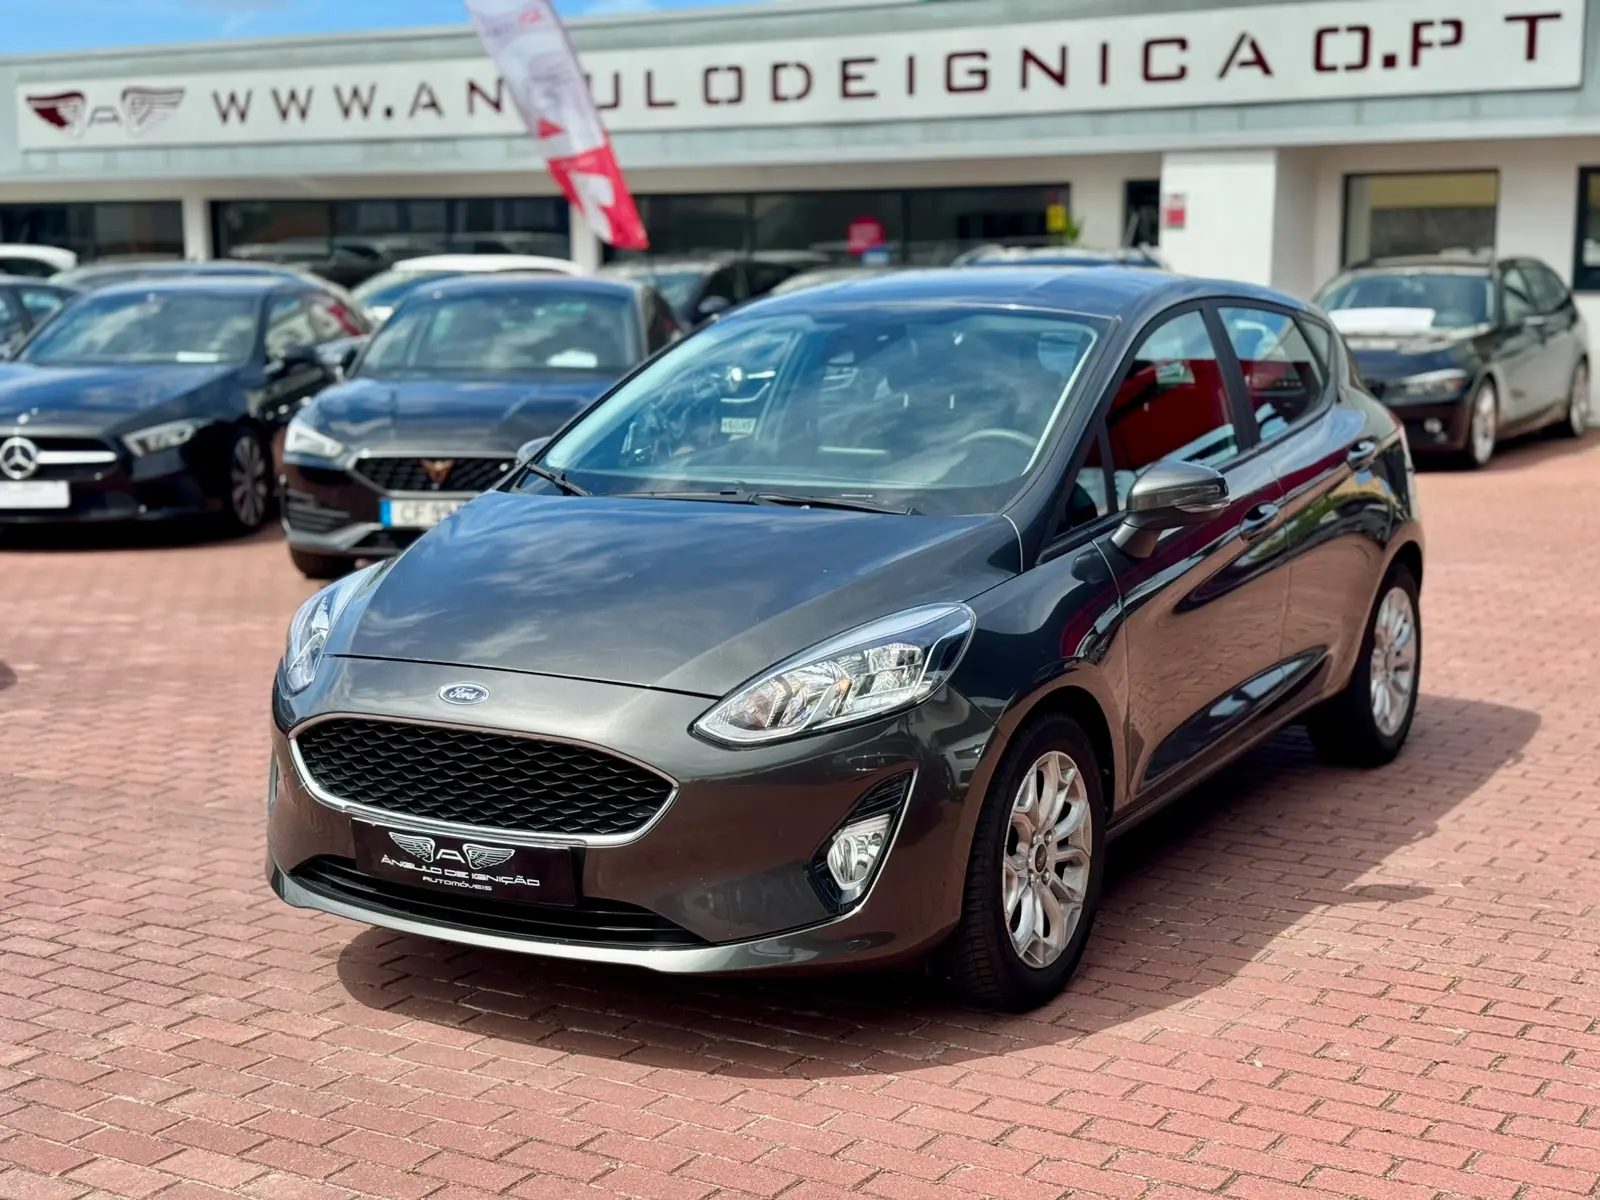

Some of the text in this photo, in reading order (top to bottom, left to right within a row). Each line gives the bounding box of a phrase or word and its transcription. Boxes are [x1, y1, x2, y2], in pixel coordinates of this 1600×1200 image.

[211, 12, 1562, 124] WWW.ANULODEIGNICAO.PT
[449, 687, 479, 700] Ford
[435, 849, 466, 864] A
[381, 854, 541, 887] ÂNGULO DE IGNIÇÃO
[422, 876, 493, 891] AUTOMÓVEIS
